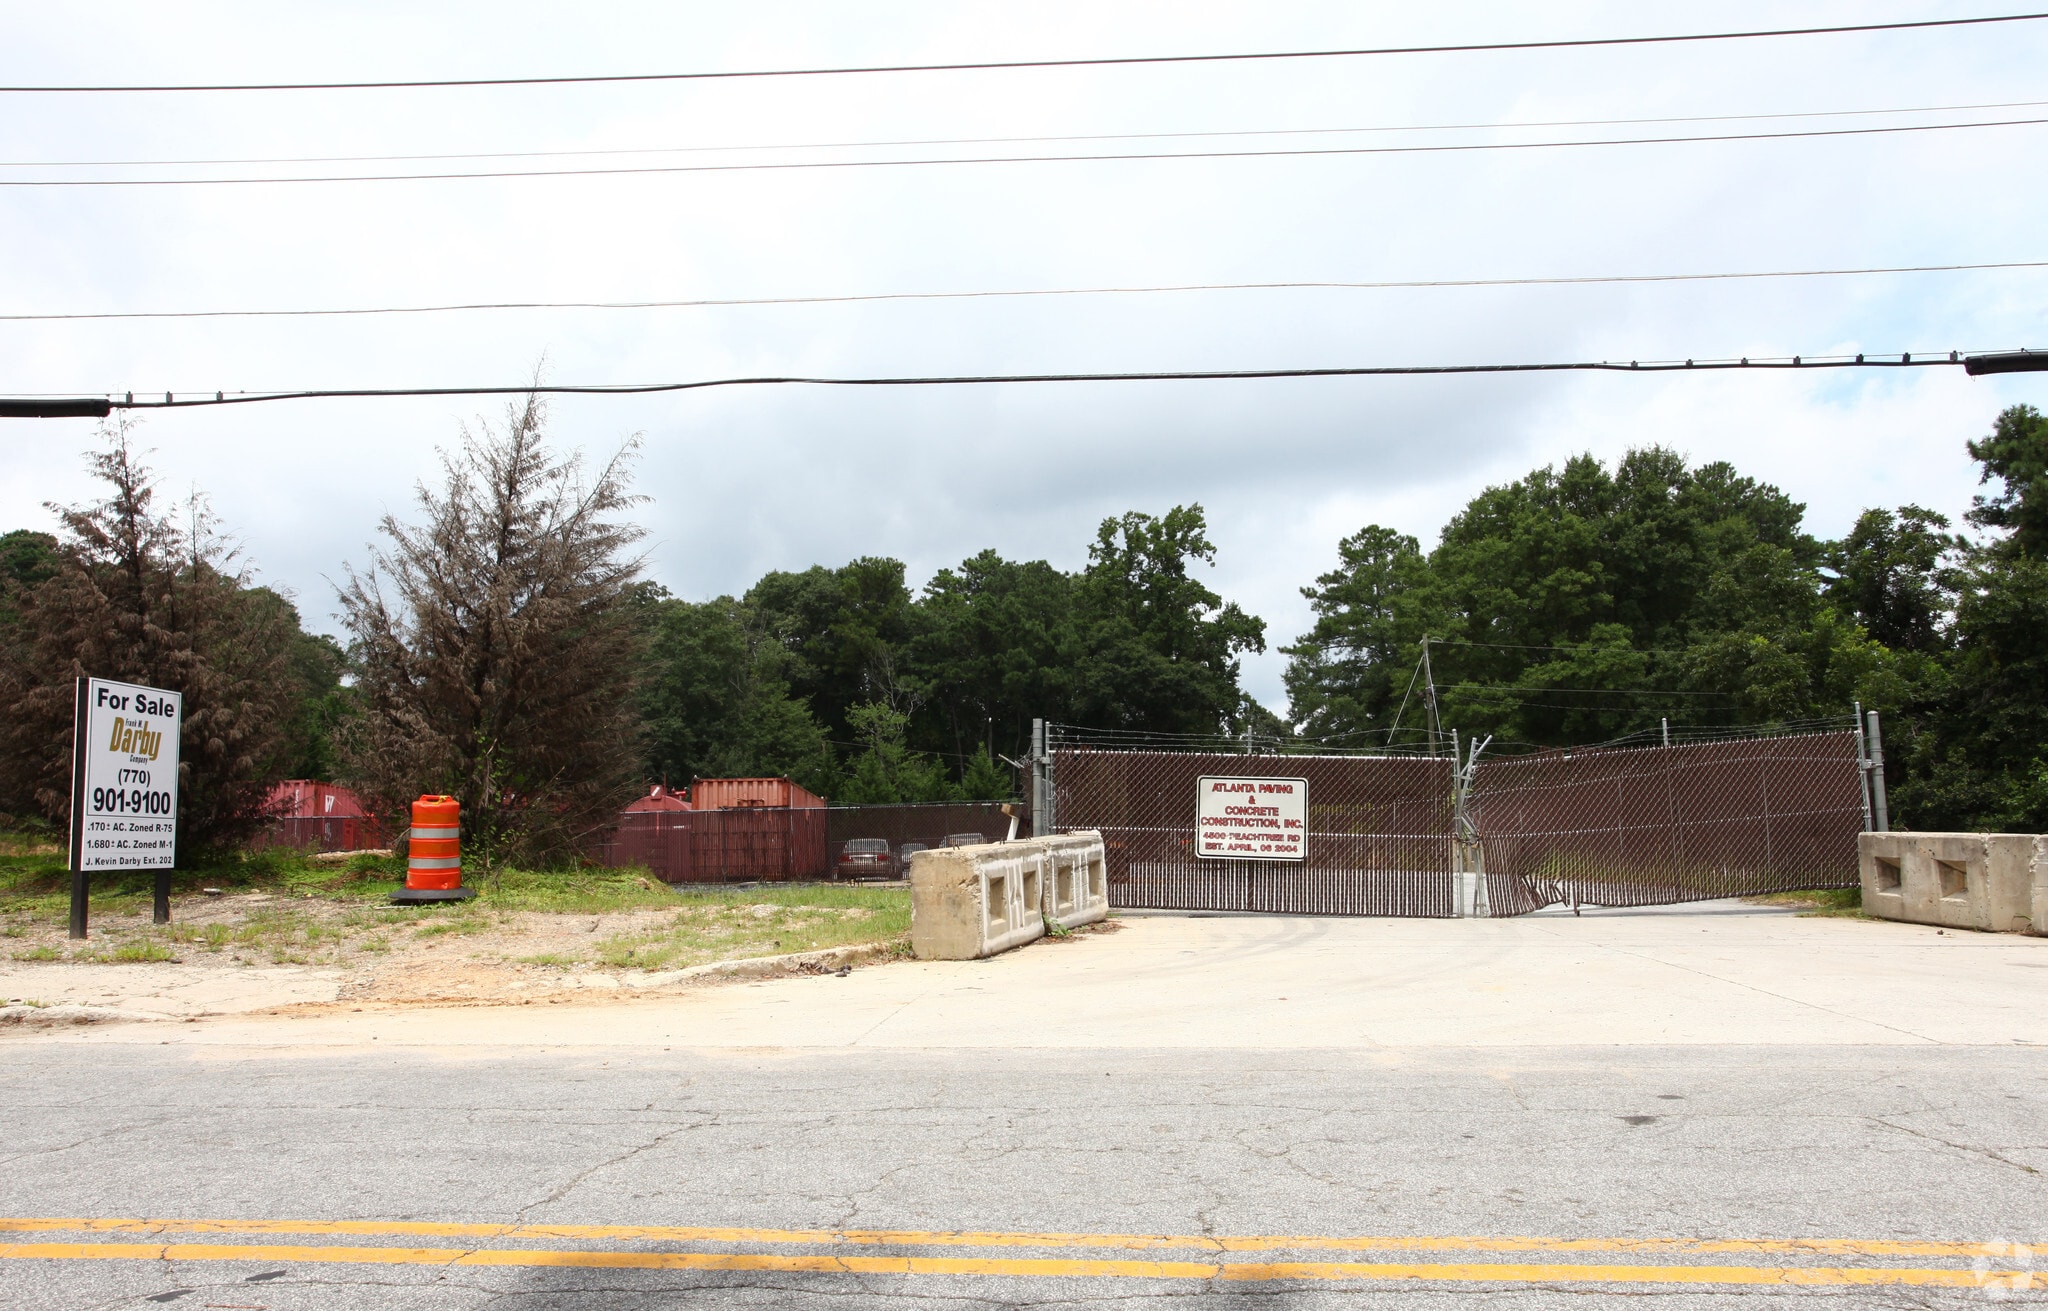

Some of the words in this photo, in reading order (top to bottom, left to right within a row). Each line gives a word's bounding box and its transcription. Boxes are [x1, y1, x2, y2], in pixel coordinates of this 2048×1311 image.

[98, 687, 130, 710] For
[135, 694, 174, 718] Sale
[109, 716, 161, 761] Darby
[130, 754, 148, 765] Company
[118, 768, 151, 788] (770)
[1212, 783, 1255, 793] ATLANTA
[1259, 784, 1293, 794] PAVING
[94, 787, 170, 814] 901-9100
[1248, 795, 1256, 804] &
[1225, 806, 1279, 816] CONCRETE
[113, 822, 127, 832] AC.
[129, 823, 153, 832] Zoned
[156, 824, 173, 832] R-75
[1200, 817, 1280, 829] CONSTRUCTION,
[1284, 819, 1303, 828] INC.
[1287, 834, 1300, 842] RD
[117, 840, 130, 849] AC.
[133, 840, 157, 849] Zoned
[159, 840, 173, 848] M-1
[1205, 842, 1224, 850] EST.
[1227, 843, 1257, 852] APRIL,
[86, 858, 93, 866] J.
[95, 858, 117, 866] Kevin
[120, 857, 140, 866] Darby
[144, 856, 158, 864] Ext.
[160, 856, 172, 864] 202
